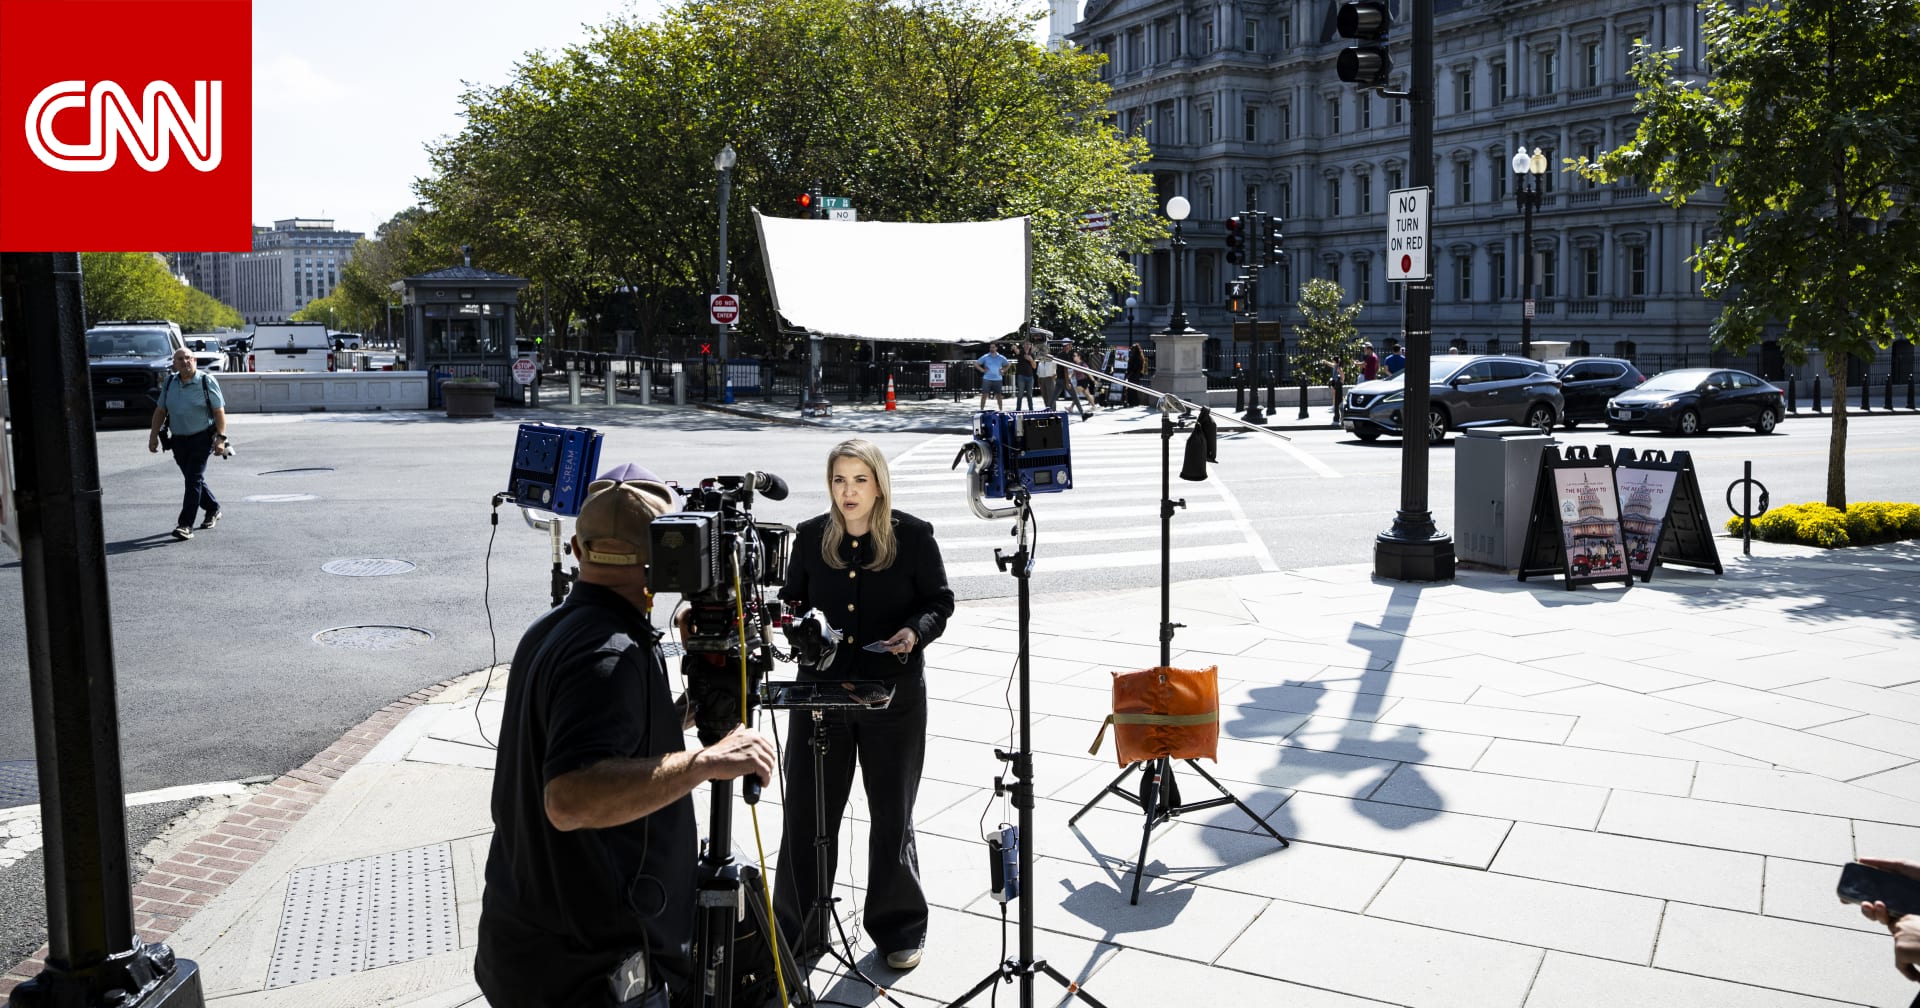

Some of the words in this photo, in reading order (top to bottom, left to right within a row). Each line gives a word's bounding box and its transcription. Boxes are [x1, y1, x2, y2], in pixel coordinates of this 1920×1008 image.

[827, 198, 836, 206] 17
[1399, 195, 1416, 213] NO
[1396, 217, 1419, 232] TURN
[1391, 237, 1402, 251] ON
[1406, 235, 1423, 250] RED
